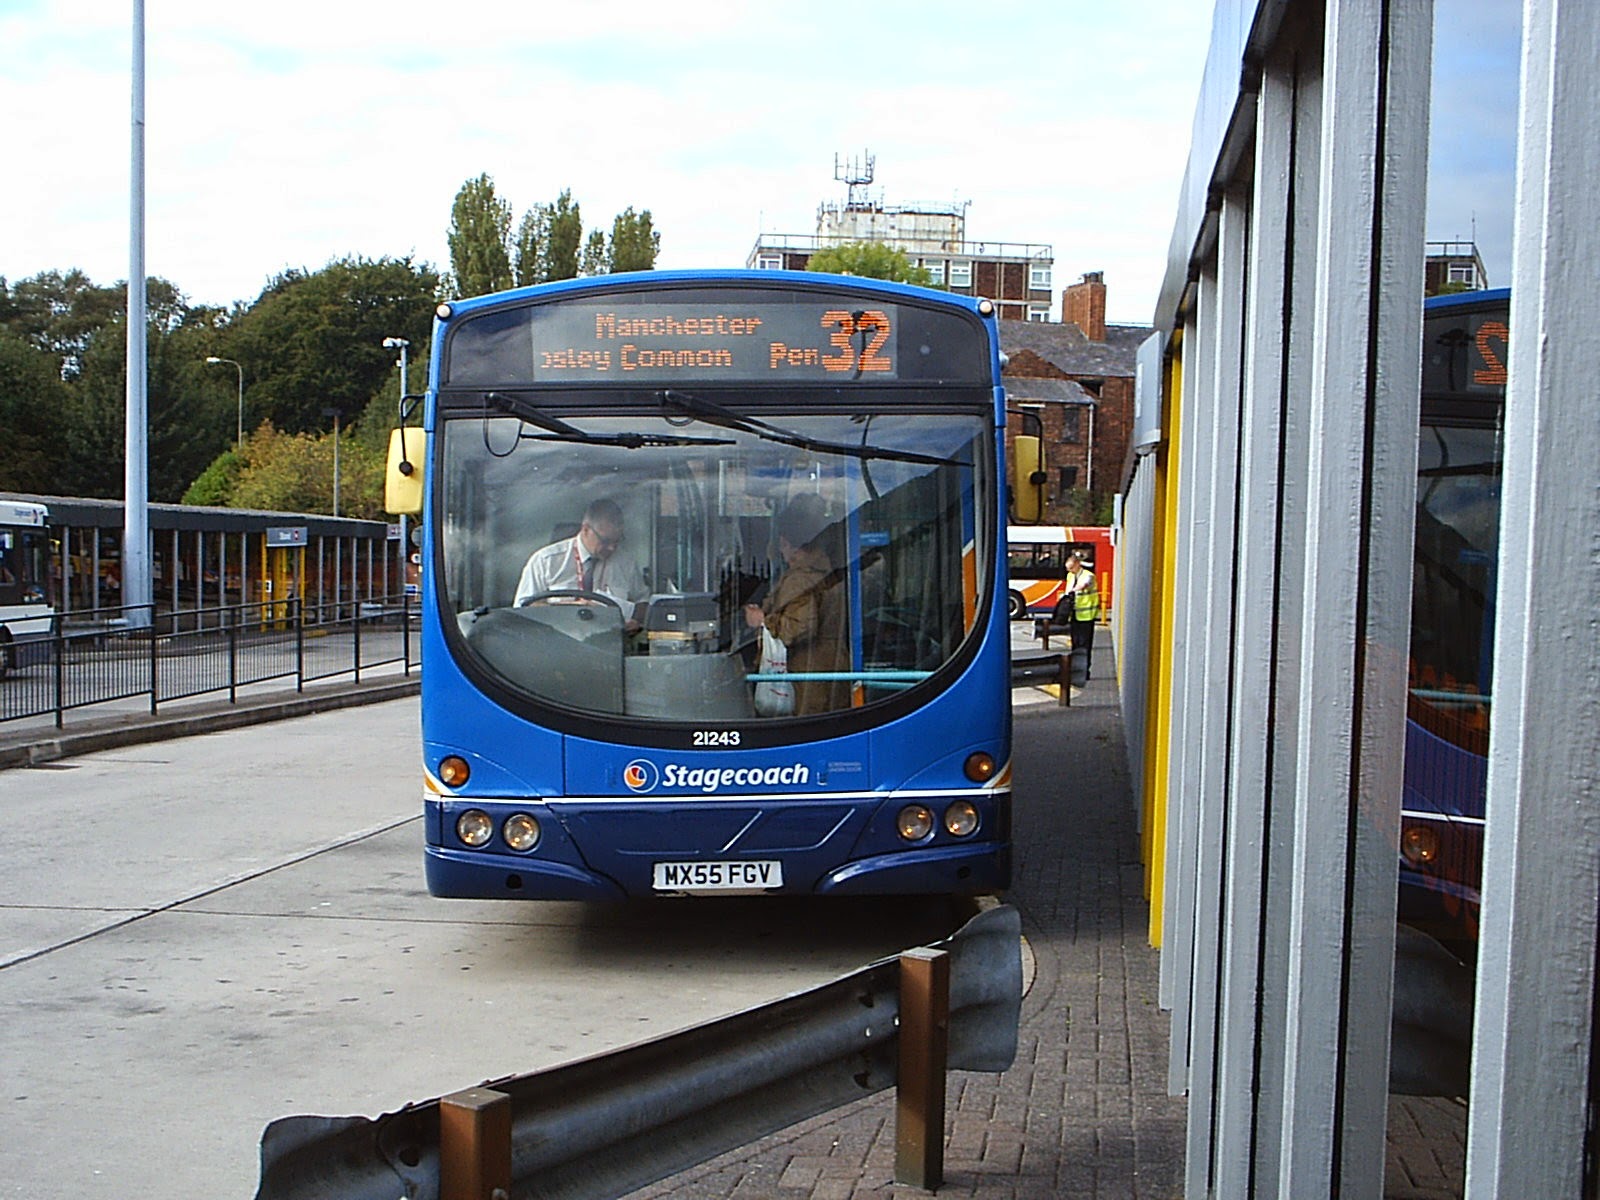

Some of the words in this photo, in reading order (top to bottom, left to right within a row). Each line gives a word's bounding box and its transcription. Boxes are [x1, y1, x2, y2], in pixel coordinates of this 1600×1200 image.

[595, 312, 763, 340] Manchester
[821, 310, 892, 372] 32
[620, 344, 732, 371] Common
[692, 731, 741, 746] 21243
[662, 763, 809, 792] Stagecoach
[664, 864, 723, 886] MX55
[728, 863, 771, 885] FGV
